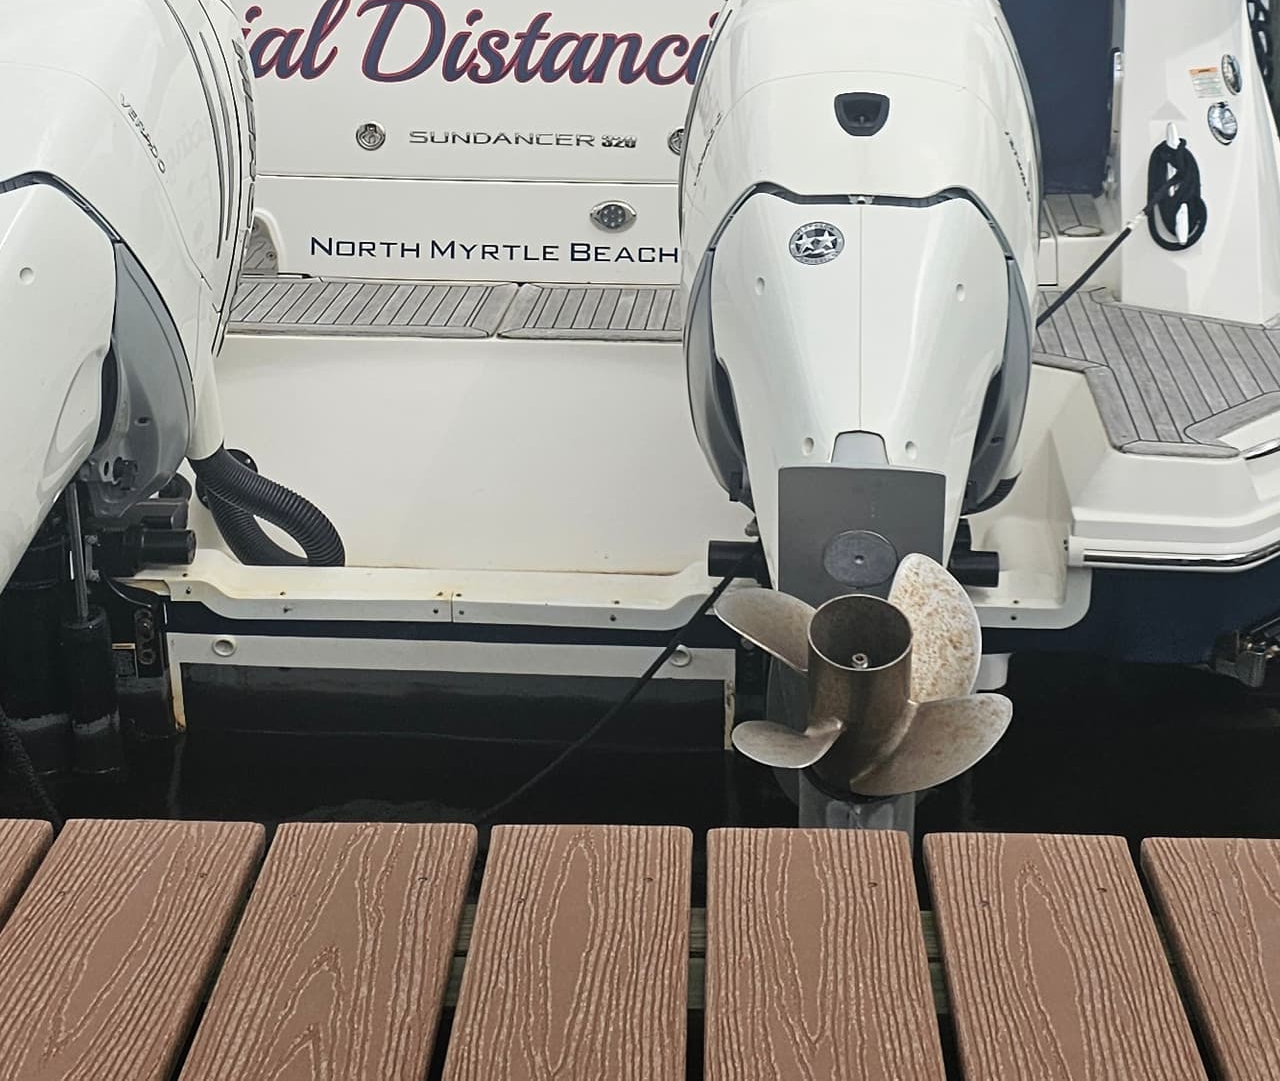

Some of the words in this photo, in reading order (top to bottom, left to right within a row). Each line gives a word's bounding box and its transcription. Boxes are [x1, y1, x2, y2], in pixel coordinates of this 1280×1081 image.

[408, 130, 596, 148] SUNDANCER
[310, 236, 421, 259] NORTH
[430, 240, 560, 262] MYRTLE
[570, 242, 679, 264] BEACH
